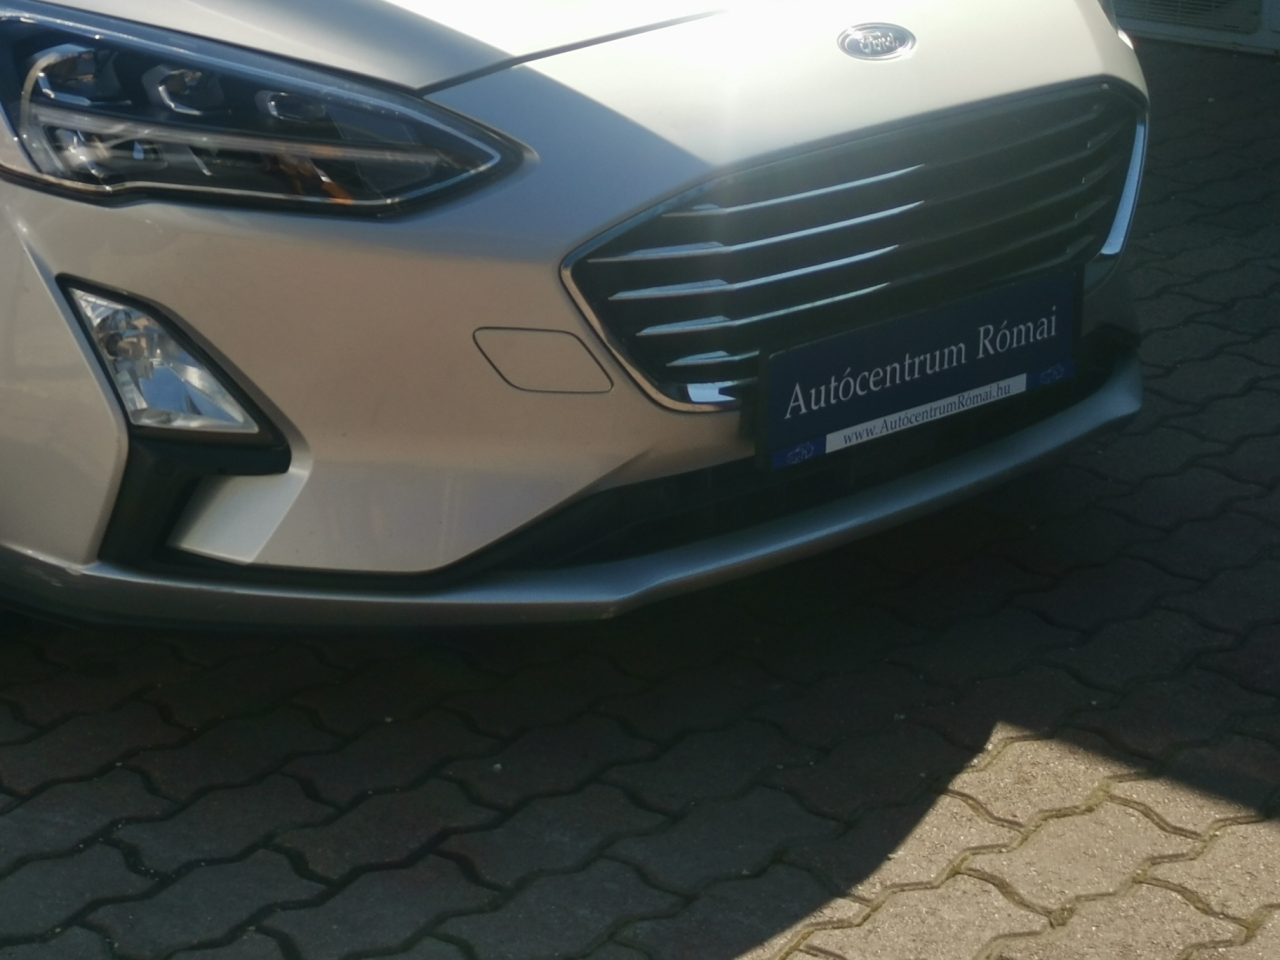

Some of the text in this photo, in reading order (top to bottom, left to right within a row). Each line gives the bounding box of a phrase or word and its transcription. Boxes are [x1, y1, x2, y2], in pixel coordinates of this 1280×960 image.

[783, 304, 1058, 420] Autócentrum Római
[842, 382, 1012, 446] www.AutócentrumRómai.hu
